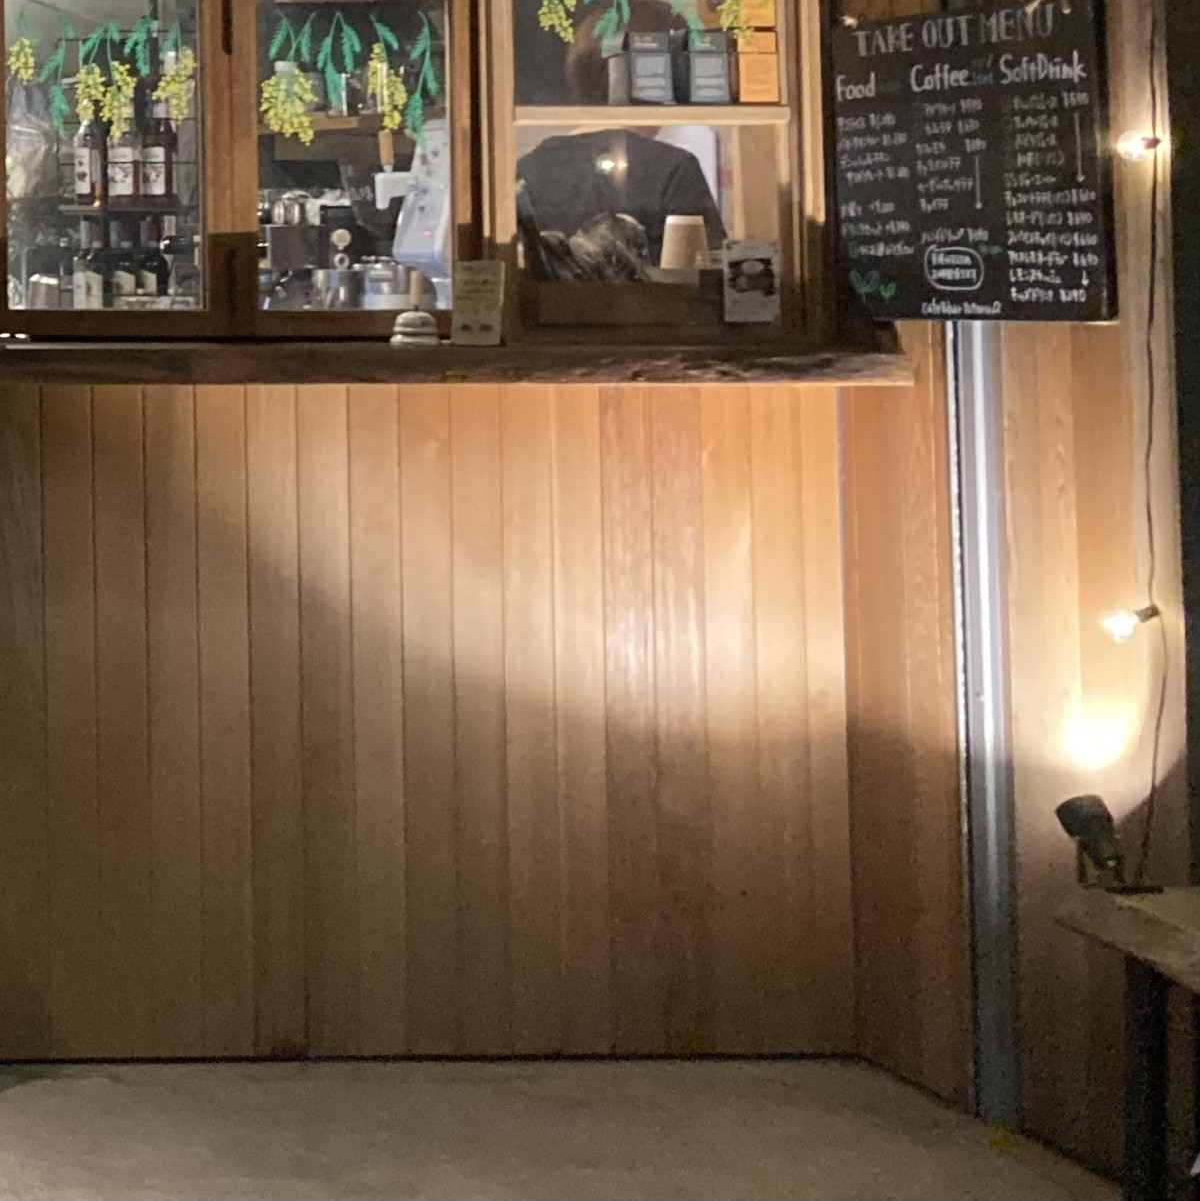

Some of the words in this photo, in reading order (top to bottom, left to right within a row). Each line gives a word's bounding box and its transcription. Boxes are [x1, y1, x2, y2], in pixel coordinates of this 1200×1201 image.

[853, 23, 914, 57] TAKE
[922, 14, 973, 49] OUT
[979, 3, 1054, 43] MENU
[836, 72, 876, 102] Food
[910, 63, 970, 93] Coffee
